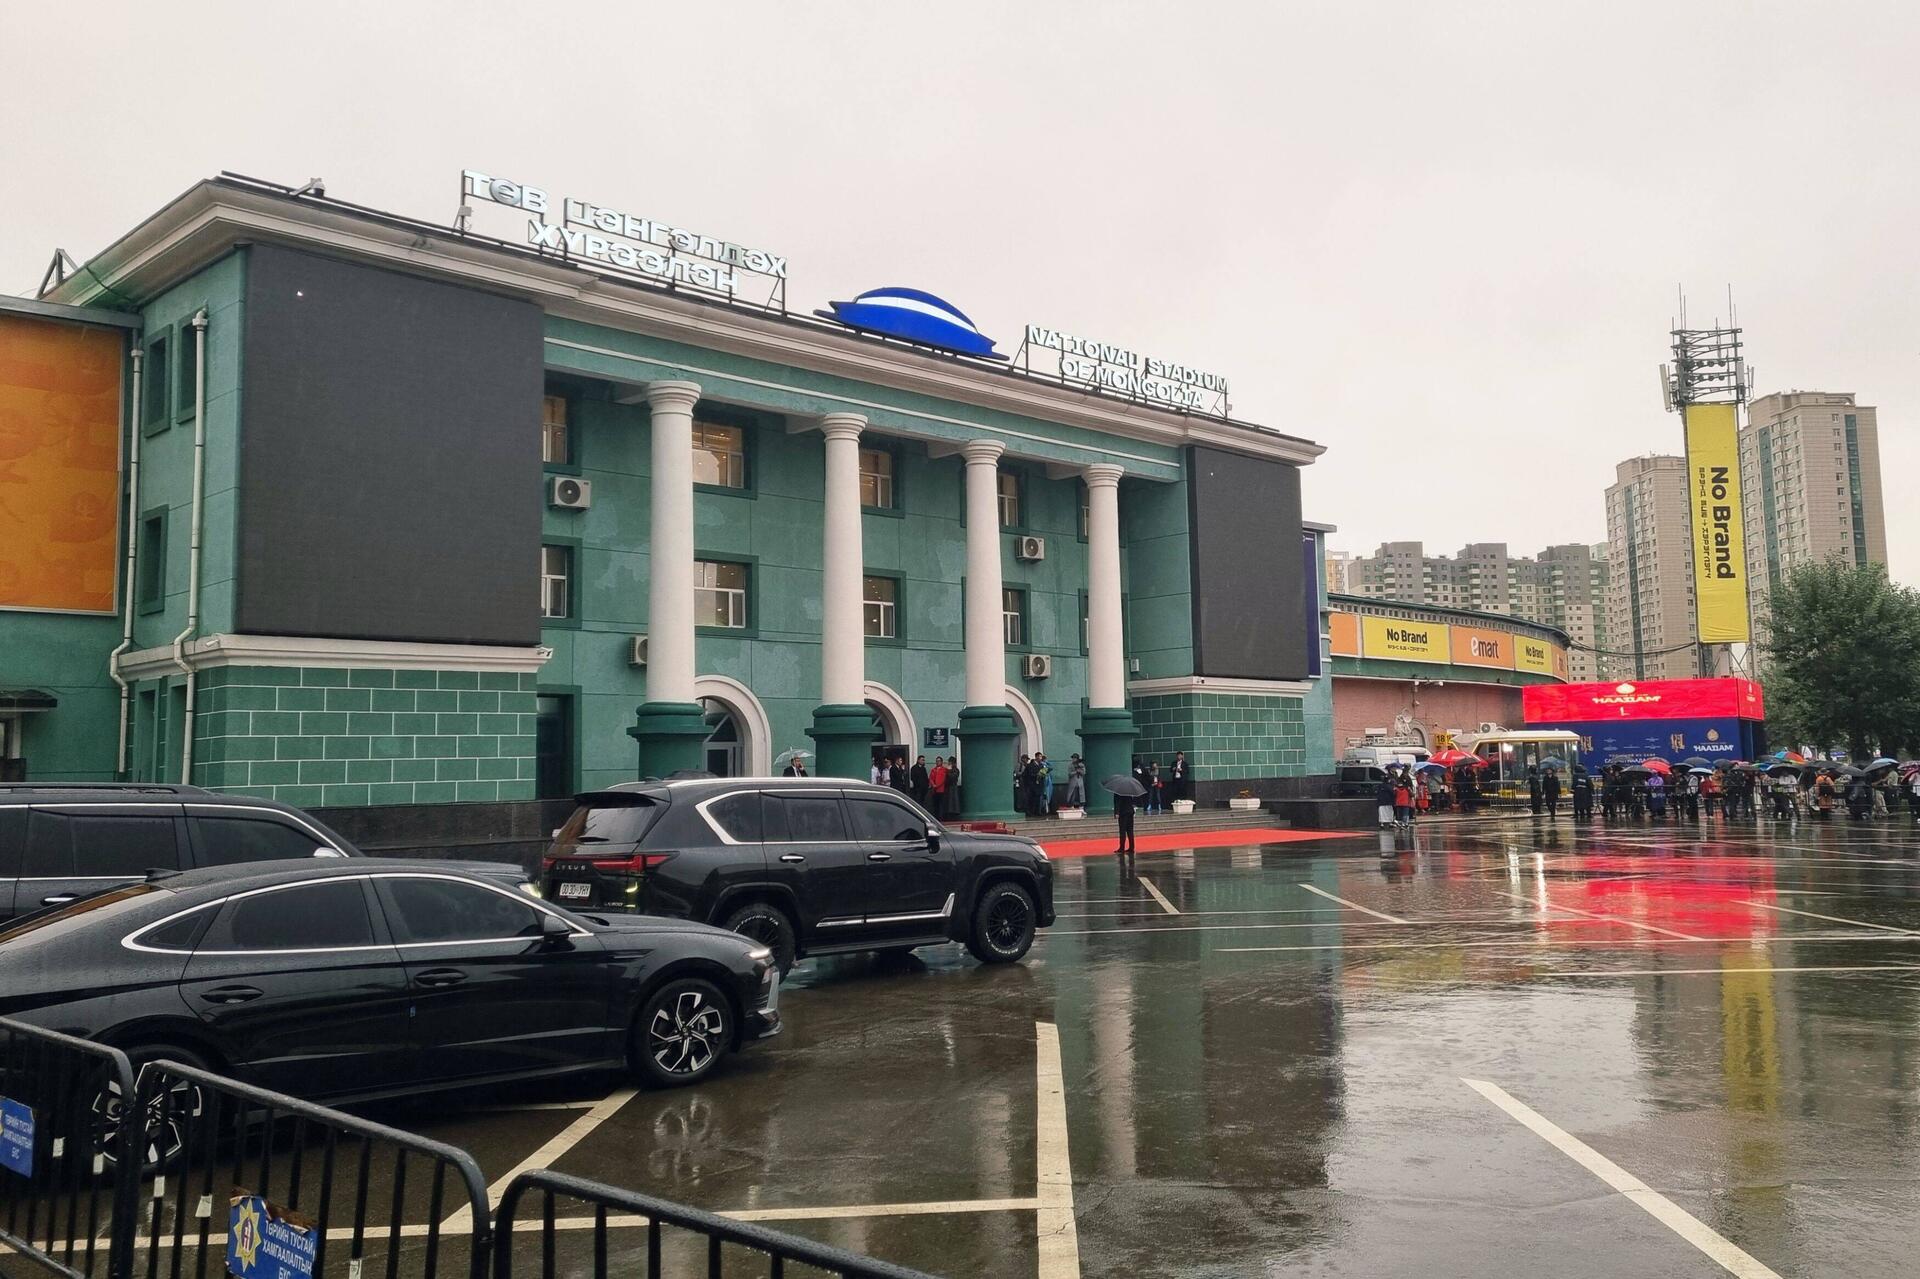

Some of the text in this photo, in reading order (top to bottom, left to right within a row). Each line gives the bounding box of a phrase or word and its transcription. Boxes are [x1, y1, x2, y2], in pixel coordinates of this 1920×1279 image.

[463, 170, 786, 279] ТӨВ ЦЭНГЭЛДЭХ
[528, 219, 739, 294] ХҮРЭЭЛЭН
[1027, 325, 1229, 393] NATIONAL STADIUM
[1096, 365, 1204, 409] MONGOLIA
[1710, 467, 1736, 579] No Brand
[1386, 628, 1428, 644] No Brand
[1471, 637, 1499, 659] emart
[1526, 645, 1544, 659] No Brand
[262, 1238, 313, 1276] ХАМГААЛАЛТЫН
[265, 1220, 314, 1255] ТӨРИЙН ТУСГАЙ
